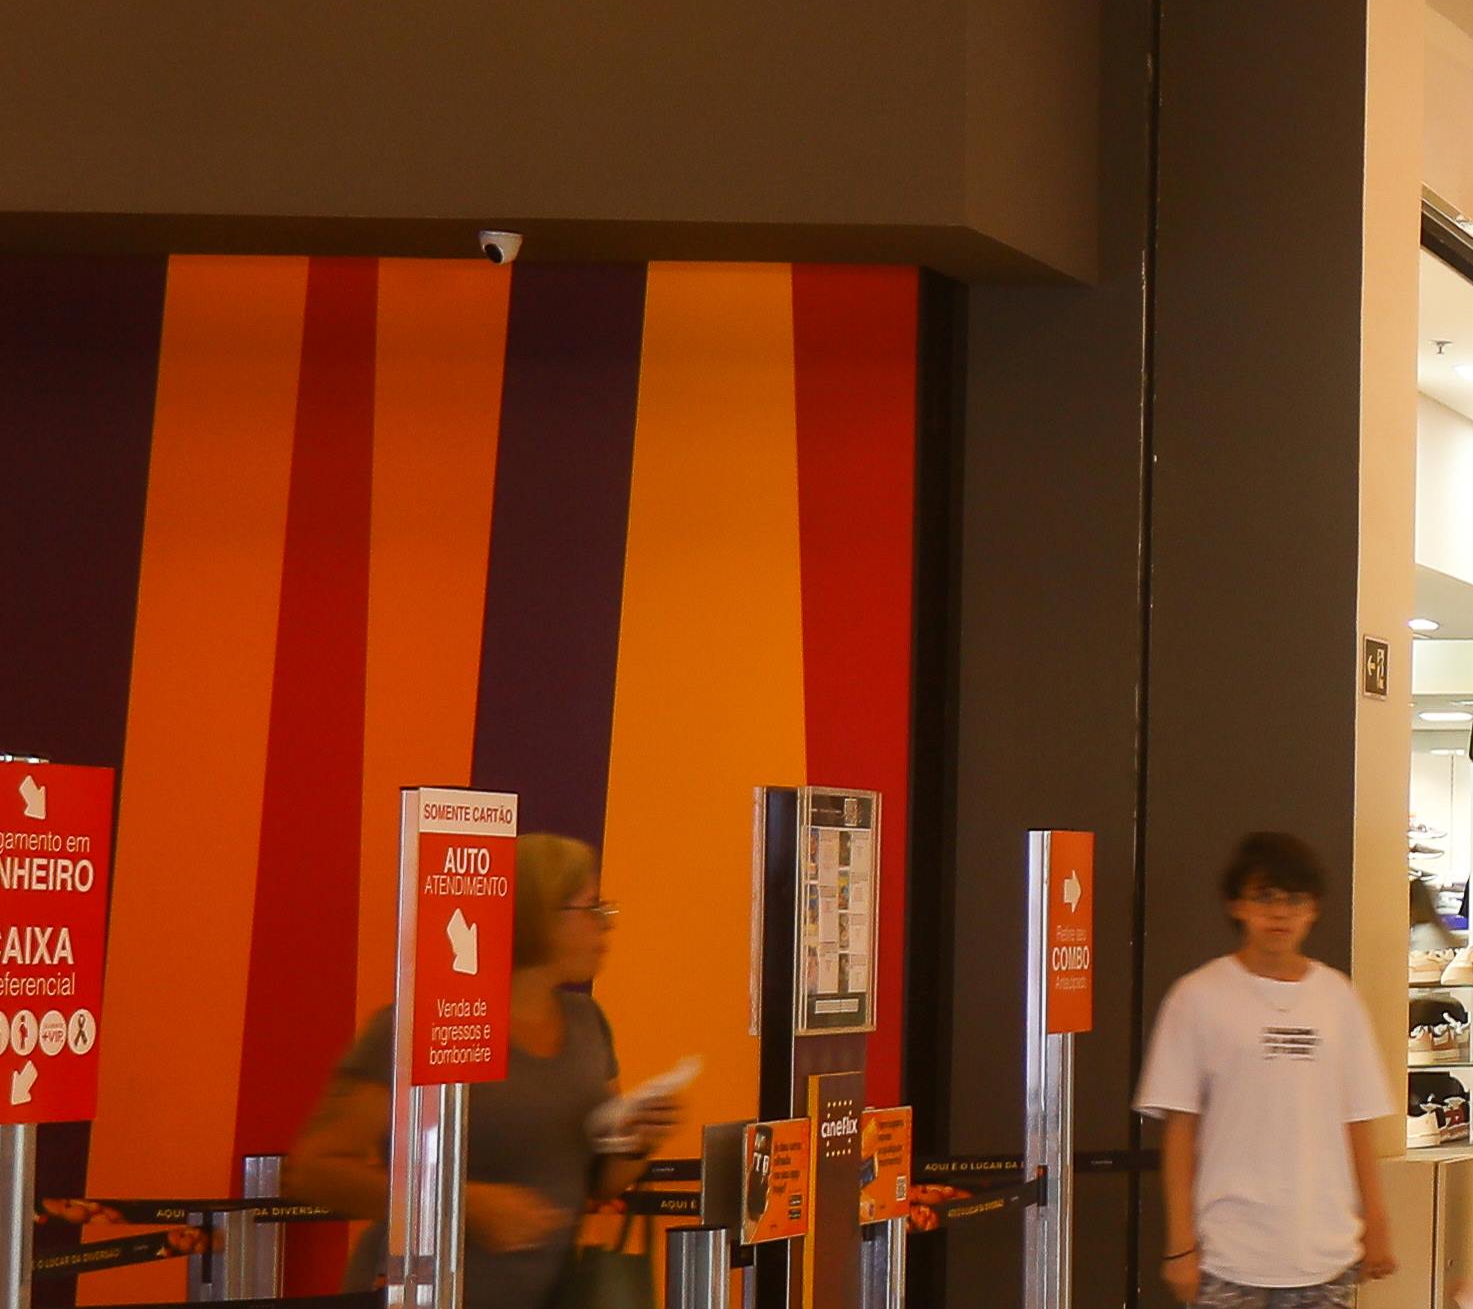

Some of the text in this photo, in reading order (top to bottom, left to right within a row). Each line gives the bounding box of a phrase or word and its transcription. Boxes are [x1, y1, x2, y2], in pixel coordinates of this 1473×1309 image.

[424, 803, 513, 824] SOMENTE CARTÃO
[66, 834, 90, 853] em
[444, 847, 490, 875] AUTO
[424, 875, 508, 897] ATENDIMENTO
[0, 926, 75, 965] AIXA
[1052, 945, 1090, 972] COMBO
[437, 997, 487, 1018] Venda de
[431, 1022, 491, 1046] ingressos e
[821, 1116, 858, 1139] cineflix
[156, 1208, 185, 1219] AQUI
[660, 1199, 687, 1210] AQUI
